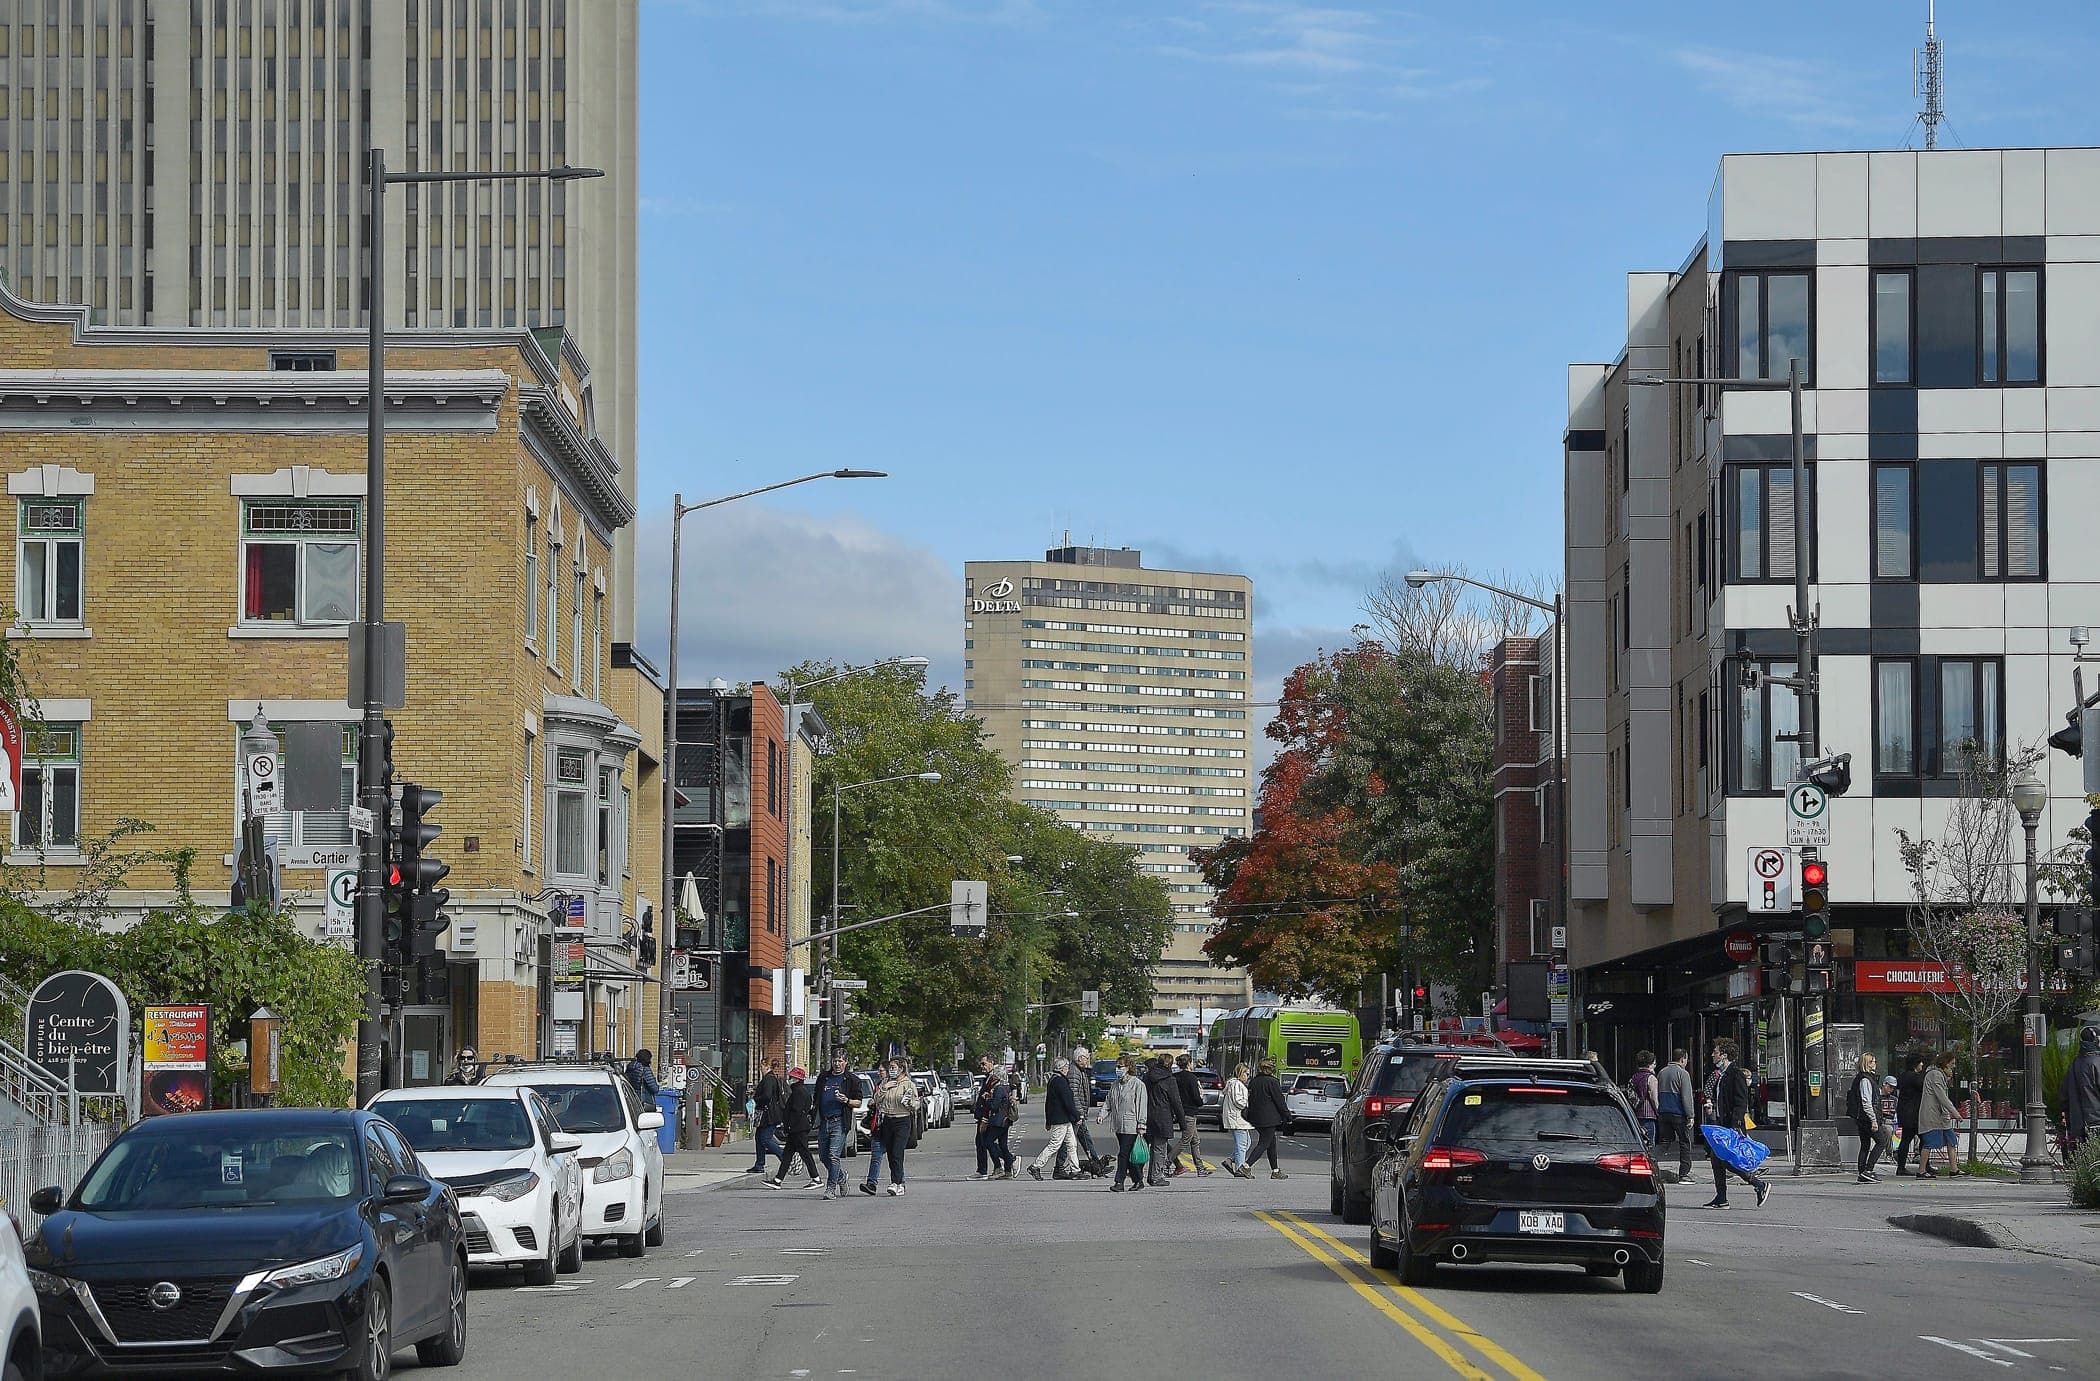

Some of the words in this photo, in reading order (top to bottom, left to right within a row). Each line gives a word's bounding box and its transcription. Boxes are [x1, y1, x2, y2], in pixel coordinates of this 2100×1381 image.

[972, 599, 1022, 613] DELTA
[0, 707, 18, 745] HANISTAN
[1813, 836, 1826, 844] VEN
[290, 857, 309, 866] Avenue
[312, 851, 350, 864] Cartier
[330, 926, 342, 934] LUN
[1886, 970, 1945, 983] CHOCOLATERIE
[48, 1013, 95, 1028] Centre
[147, 1010, 205, 1019] RESTAURANT
[37, 1018, 45, 1064] COIFFURE
[48, 1028, 66, 1041] du
[48, 1042, 112, 1055] bien-être
